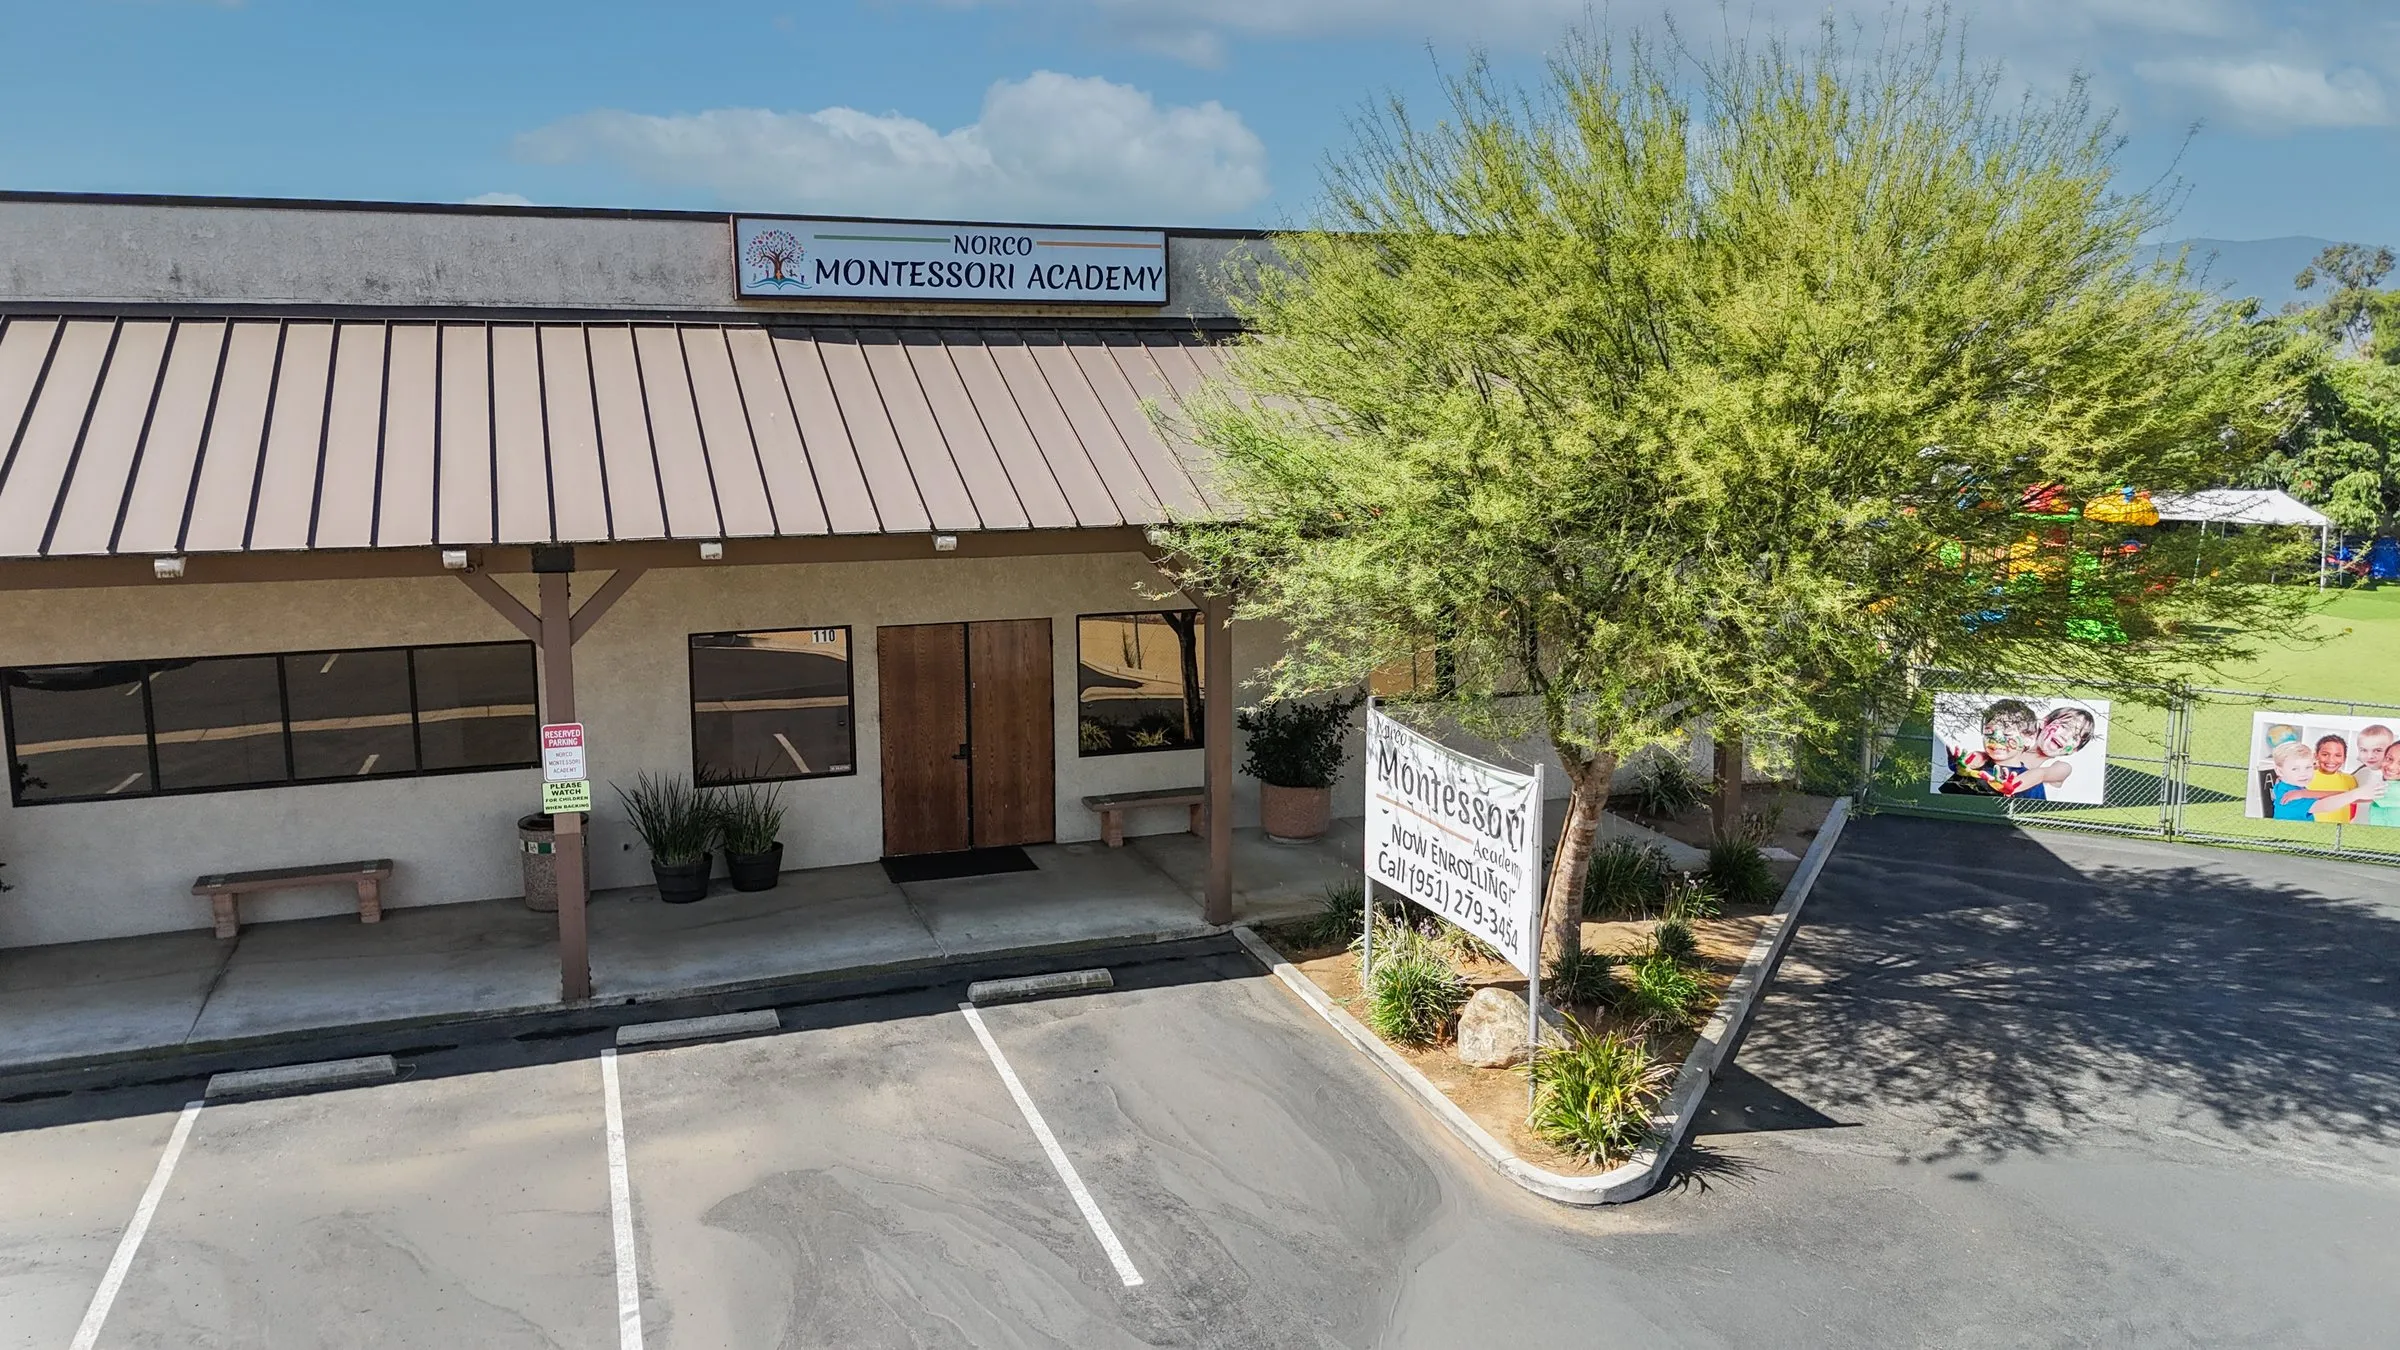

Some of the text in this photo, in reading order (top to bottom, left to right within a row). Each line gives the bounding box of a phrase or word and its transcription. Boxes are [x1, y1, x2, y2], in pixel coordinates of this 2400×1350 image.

[954, 234, 1033, 257] NORCO
[815, 257, 1163, 292] MONTESSORI ACADEMY
[813, 629, 835, 643] 110
[544, 729, 581, 739] RESERVED
[548, 737, 578, 748] PARKING
[1376, 715, 1408, 747] Norco
[549, 781, 582, 790] PLEASE
[551, 788, 581, 796] WATCH
[1378, 739, 1526, 854] Montessori
[1391, 823, 1515, 909] NOW ENROLLING!
[1473, 837, 1524, 890] Academy
[1378, 849, 1519, 956] Call (951) 279-3454
